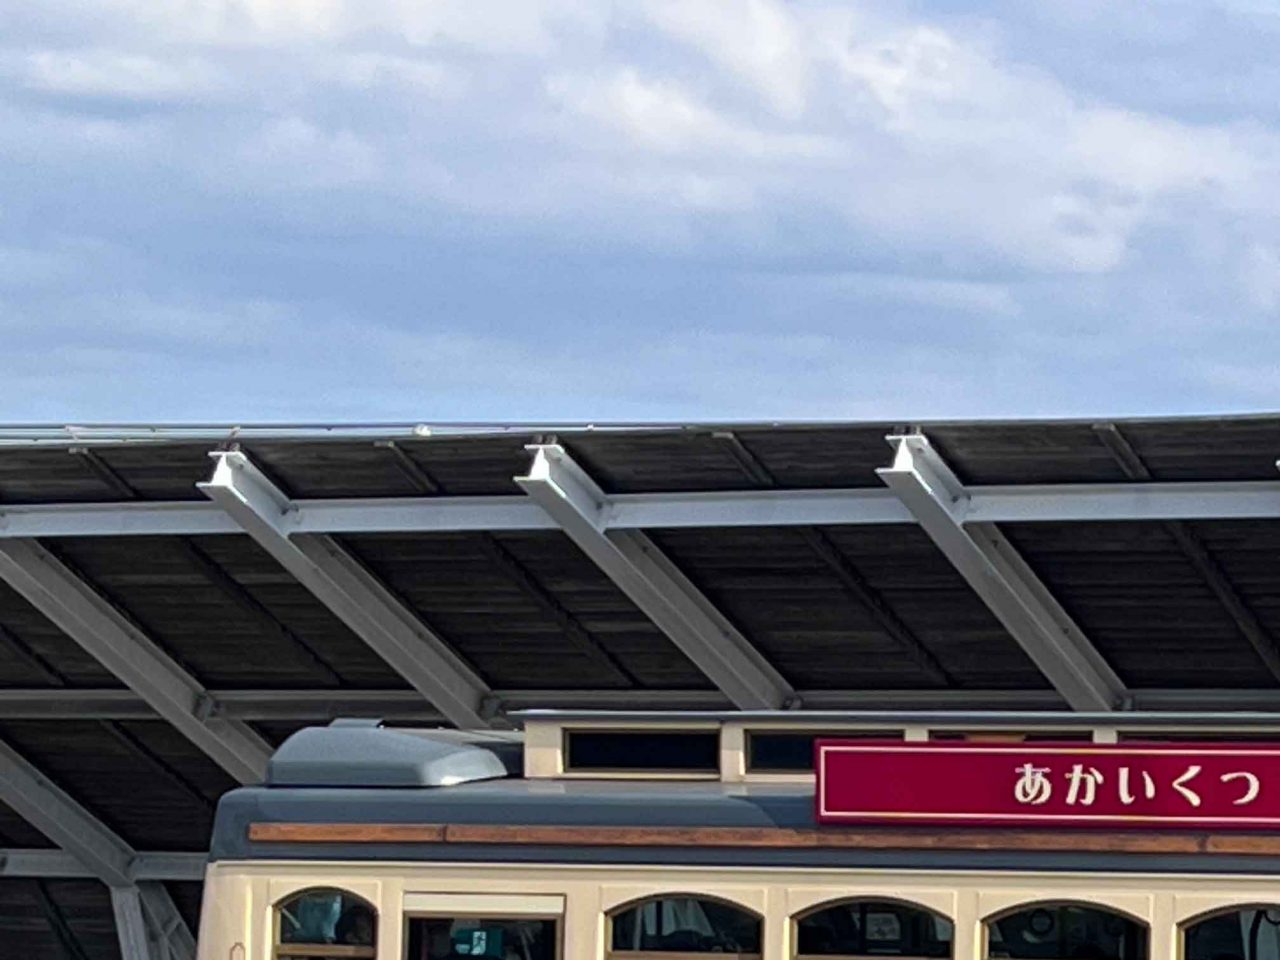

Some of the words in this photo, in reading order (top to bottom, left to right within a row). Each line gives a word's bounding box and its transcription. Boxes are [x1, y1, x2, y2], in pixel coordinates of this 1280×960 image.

[1014, 763, 1260, 807] あかいくつ
